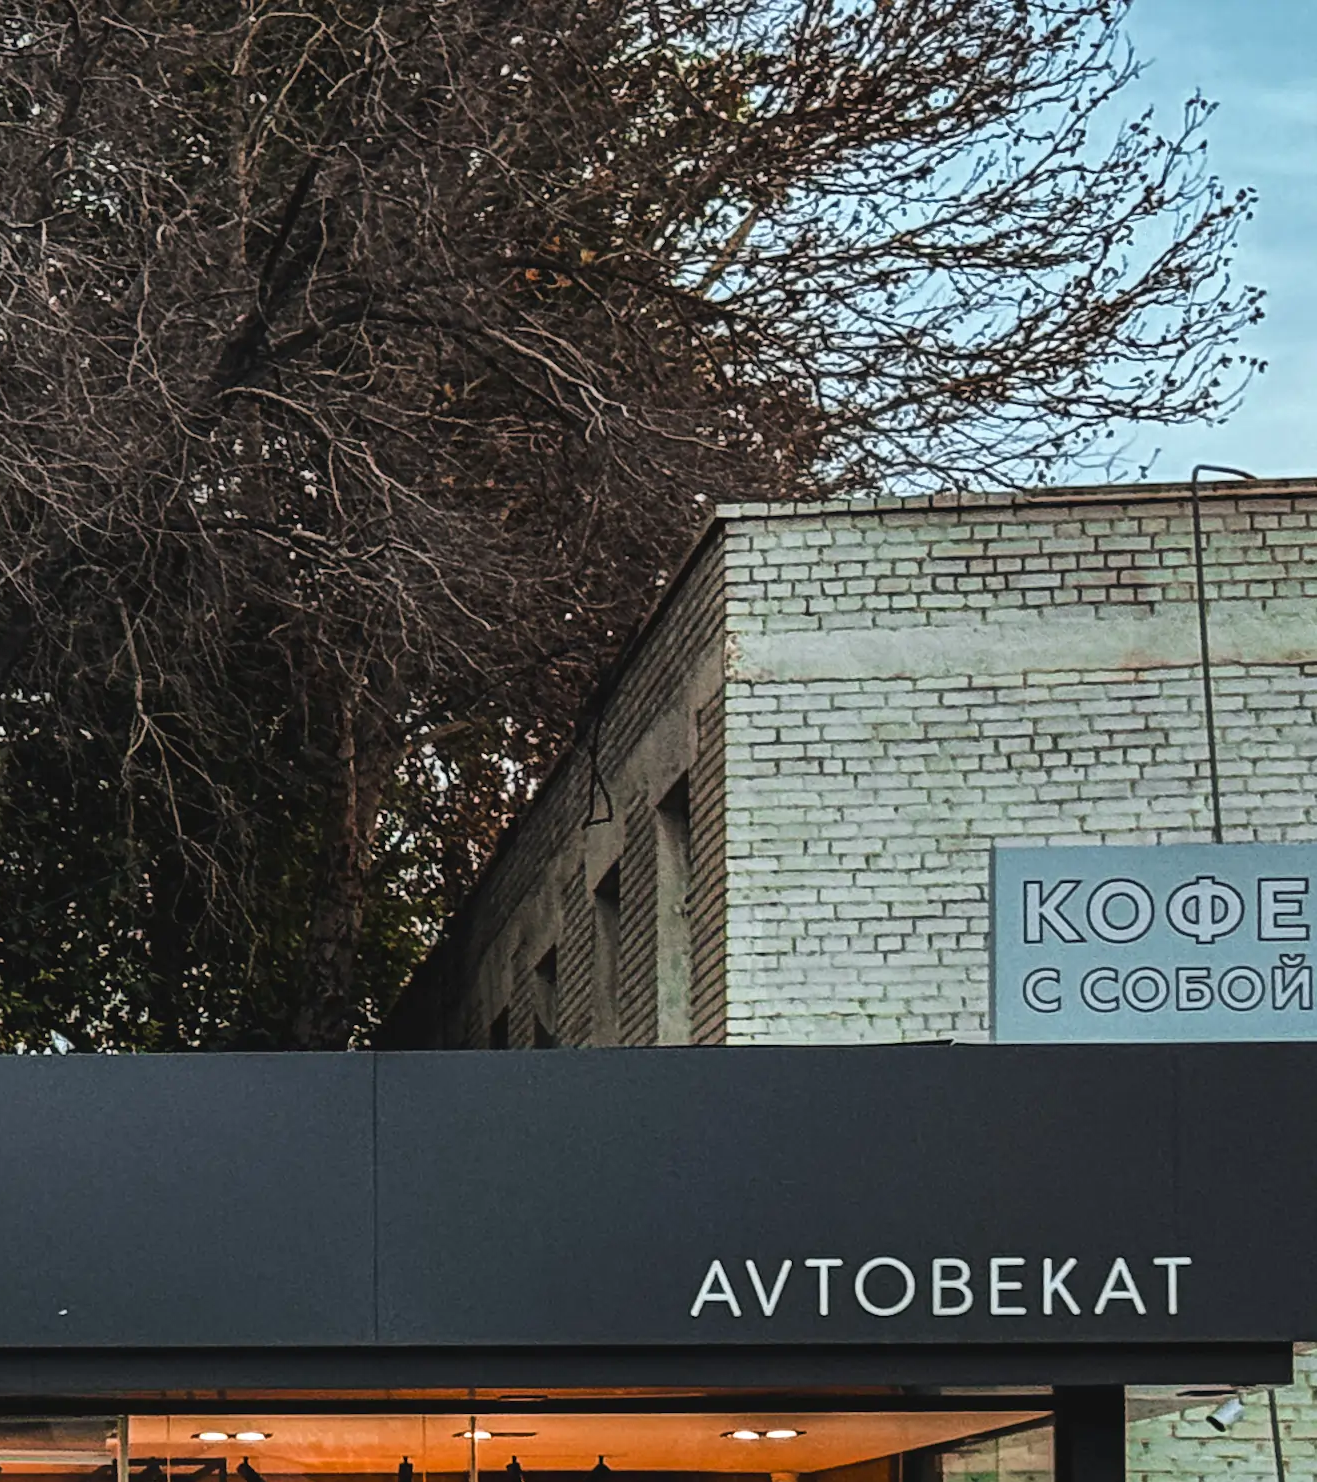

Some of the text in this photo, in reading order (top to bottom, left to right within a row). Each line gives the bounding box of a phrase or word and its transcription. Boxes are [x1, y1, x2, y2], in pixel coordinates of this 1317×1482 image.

[1022, 876, 1310, 944] КОФЕ
[1023, 953, 1314, 1013] С СОБОЙ
[690, 1256, 1192, 1318] AVTOBEKAT
